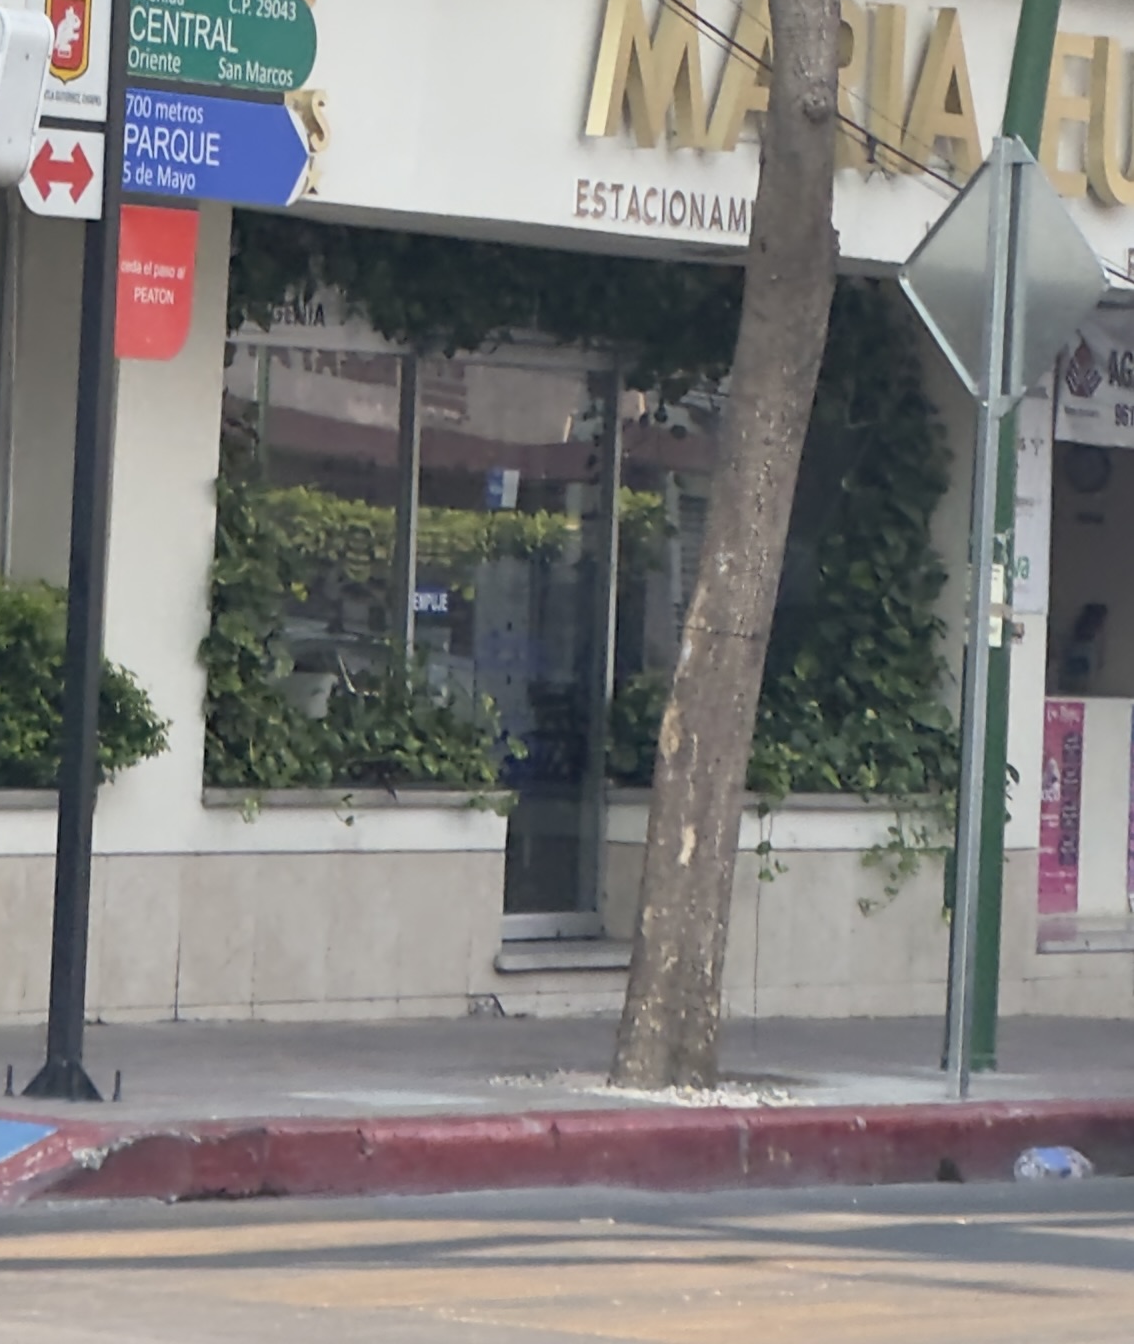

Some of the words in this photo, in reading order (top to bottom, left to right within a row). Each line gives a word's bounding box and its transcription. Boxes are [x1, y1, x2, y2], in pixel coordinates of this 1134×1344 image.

[129, 6, 239, 53] CENTRAL
[128, 46, 181, 74] Oriente
[218, 58, 242, 82] San
[245, 62, 293, 88] Marcos
[126, 94, 152, 119] 700
[156, 103, 204, 124] metros
[124, 123, 221, 167] PARQUE
[123, 161, 131, 183] 5
[135, 164, 153, 186] de
[157, 166, 196, 195] Mayo
